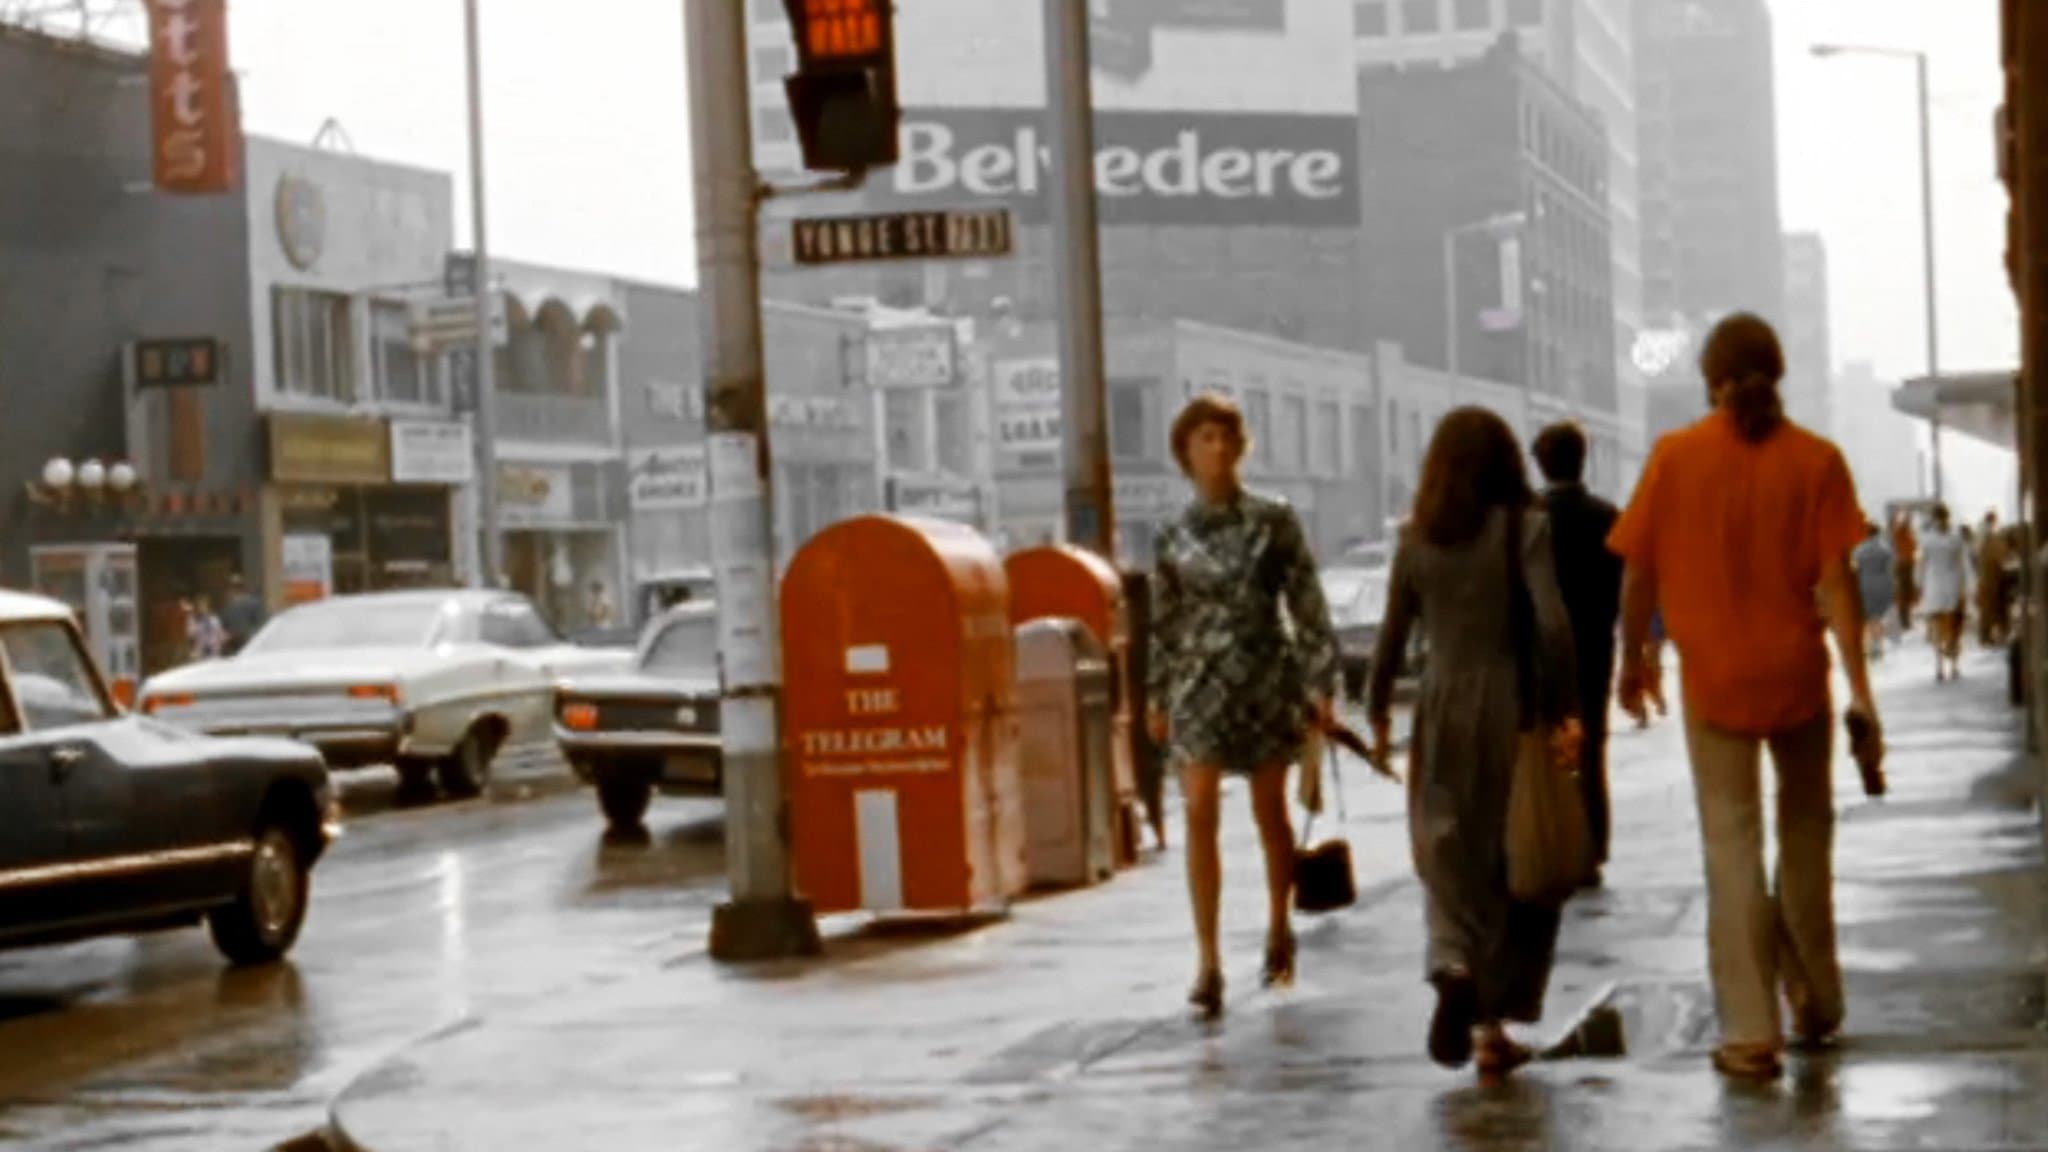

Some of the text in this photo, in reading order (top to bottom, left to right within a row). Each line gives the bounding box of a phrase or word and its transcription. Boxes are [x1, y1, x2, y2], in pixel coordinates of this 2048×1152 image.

[893, 121, 1343, 197] Beledere
[800, 220, 890, 257] YONGE
[845, 688, 899, 713] THE
[802, 726, 947, 755] TELEGRAM
